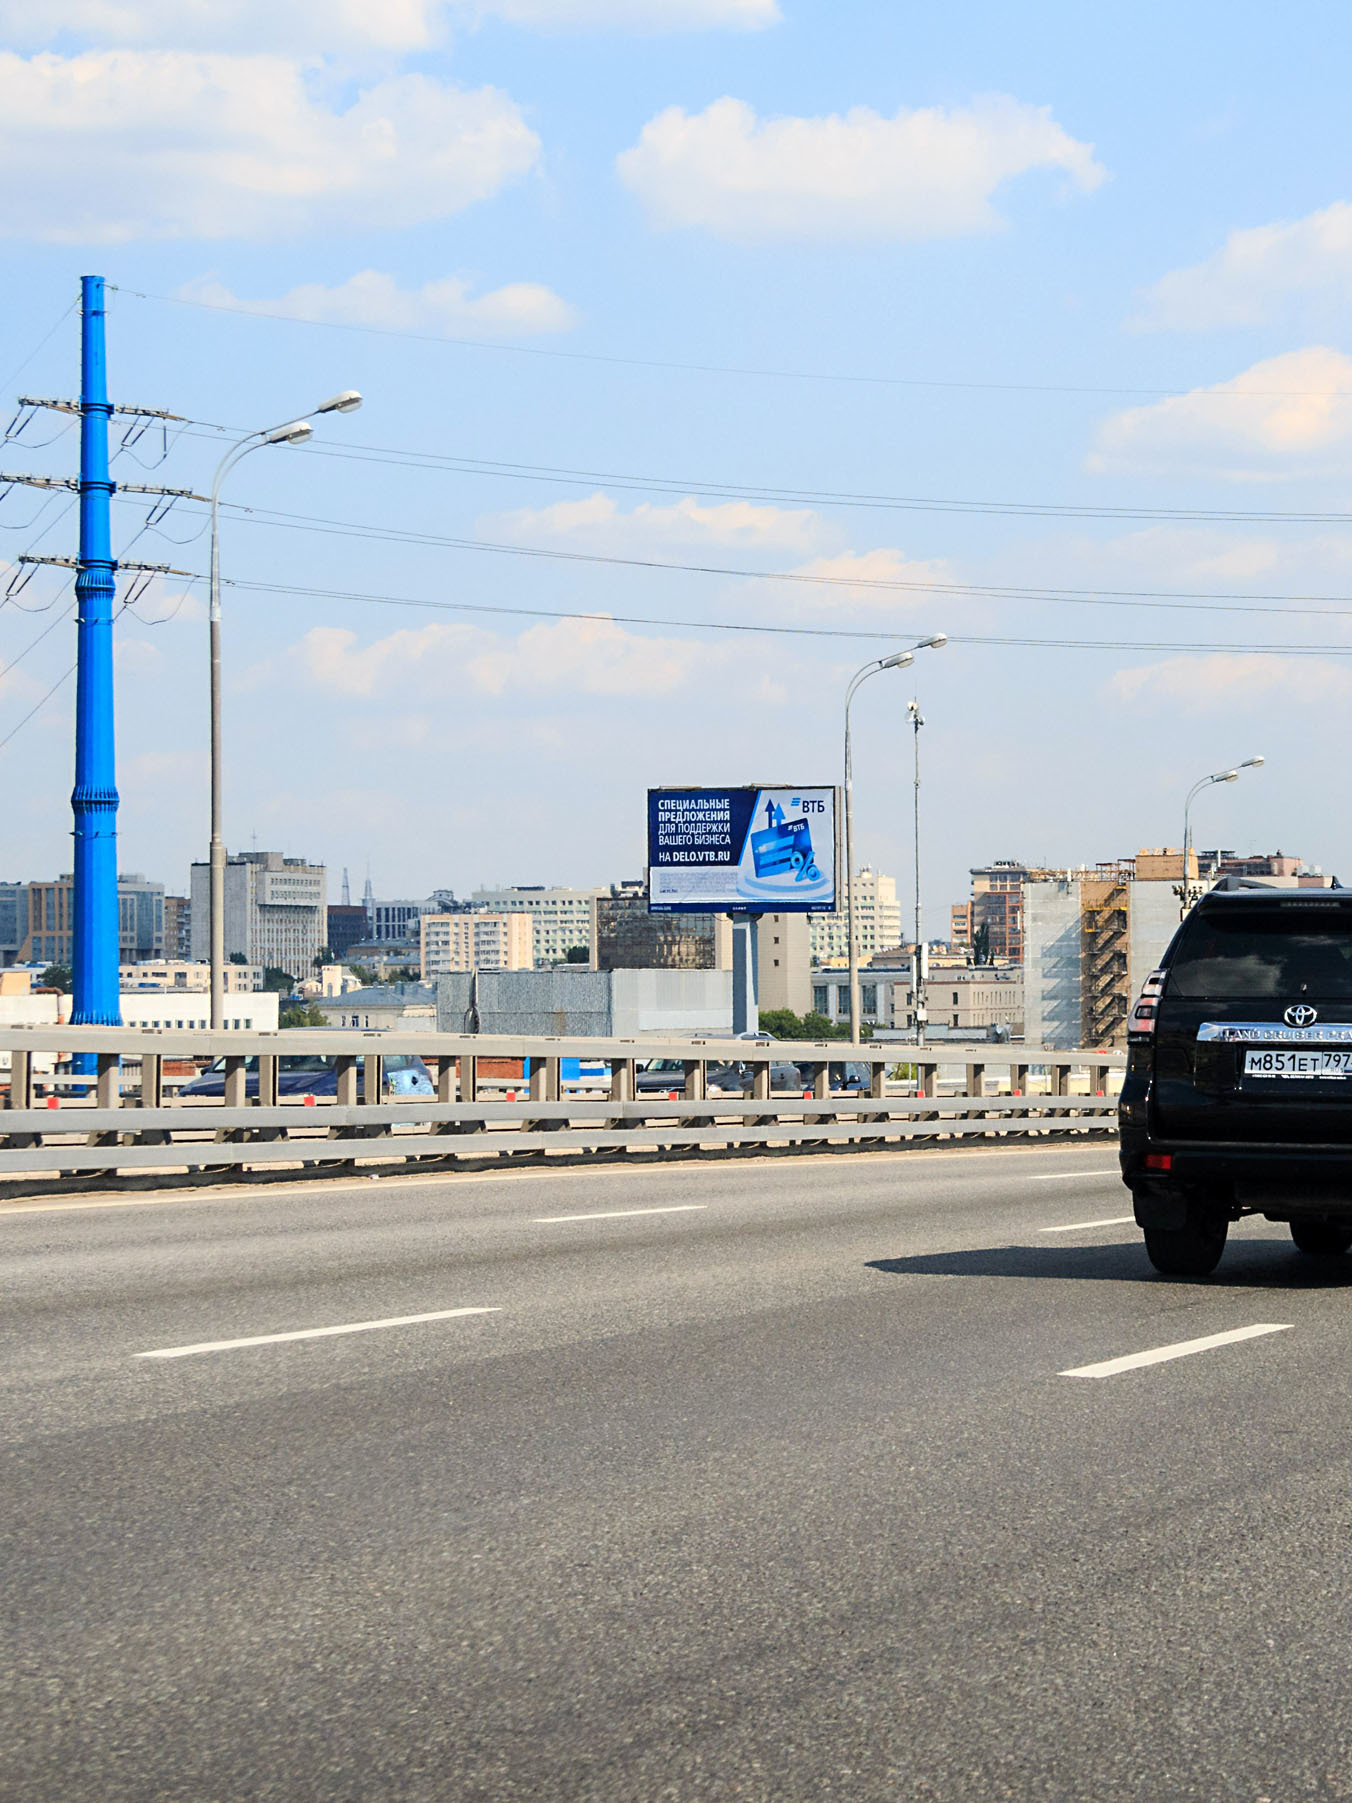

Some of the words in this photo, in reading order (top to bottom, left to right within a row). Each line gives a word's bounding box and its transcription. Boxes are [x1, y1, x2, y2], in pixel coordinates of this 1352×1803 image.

[658, 799, 730, 811] СПЕЦИАЛЬНЫЕ
[802, 800, 825, 813] ВТБ
[658, 811, 730, 823] ПРЕДЛОЖЕНИЯ
[658, 823, 676, 835] ДЛЯ
[678, 823, 730, 834] ПОДДЕРЖКИ
[658, 835, 693, 845] ВАШЕГО
[694, 834, 731, 845] БИЗНЕСА
[659, 852, 671, 862] НА
[673, 851, 730, 862] DELO.VTB.RU
[1224, 1029, 1260, 1040] LAND
[1263, 1030, 1323, 1040] CRUISER
[1250, 1054, 1319, 1072] М851ЕТ
[1324, 1054, 1351, 1067] 797
